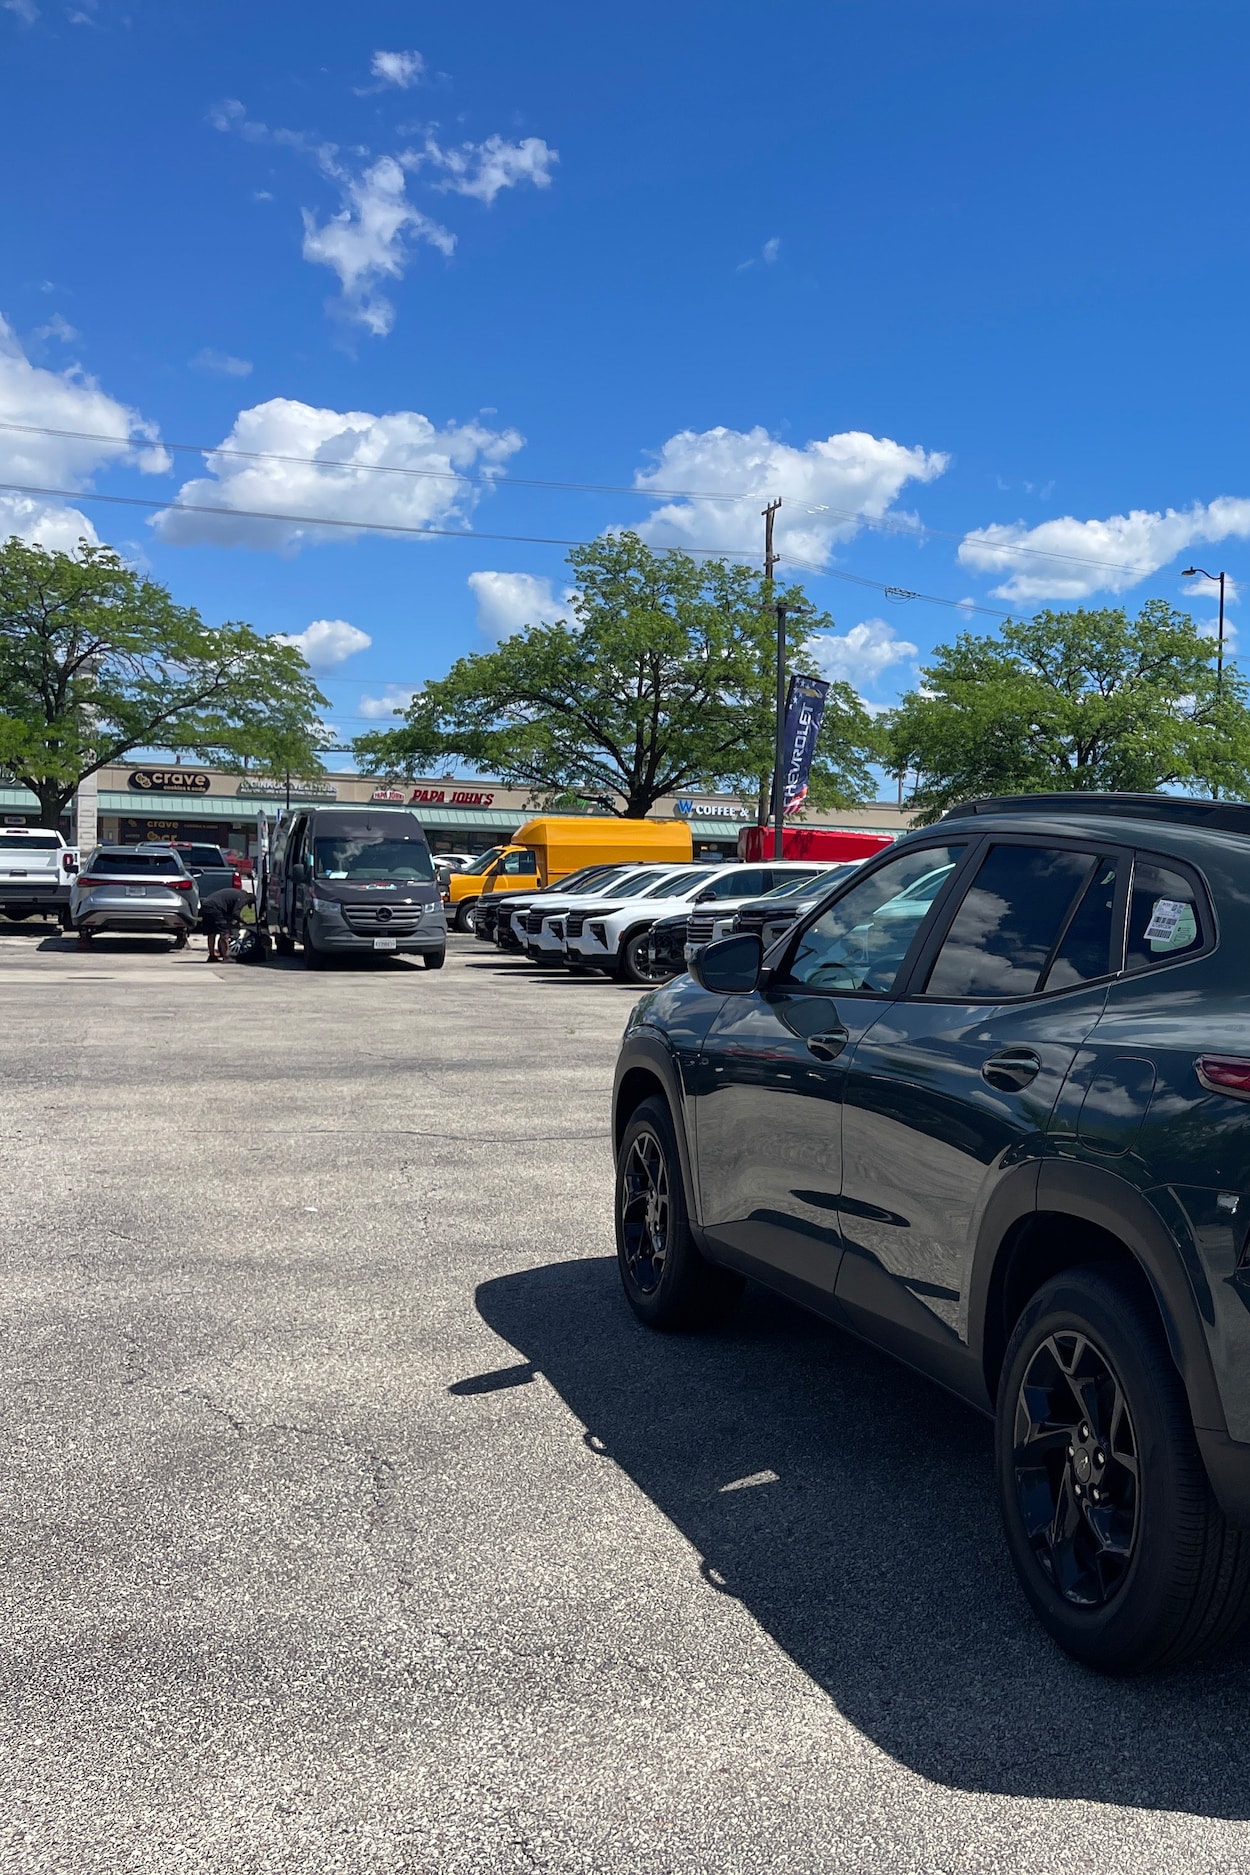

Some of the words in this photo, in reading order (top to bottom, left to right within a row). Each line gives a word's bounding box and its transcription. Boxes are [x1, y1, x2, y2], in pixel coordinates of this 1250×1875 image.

[152, 772, 206, 786] crave
[412, 789, 446, 802] PAPA
[449, 791, 495, 806] JOHN'S
[678, 799, 694, 814] W
[696, 805, 736, 817] COFFEE
[739, 808, 750, 818] &
